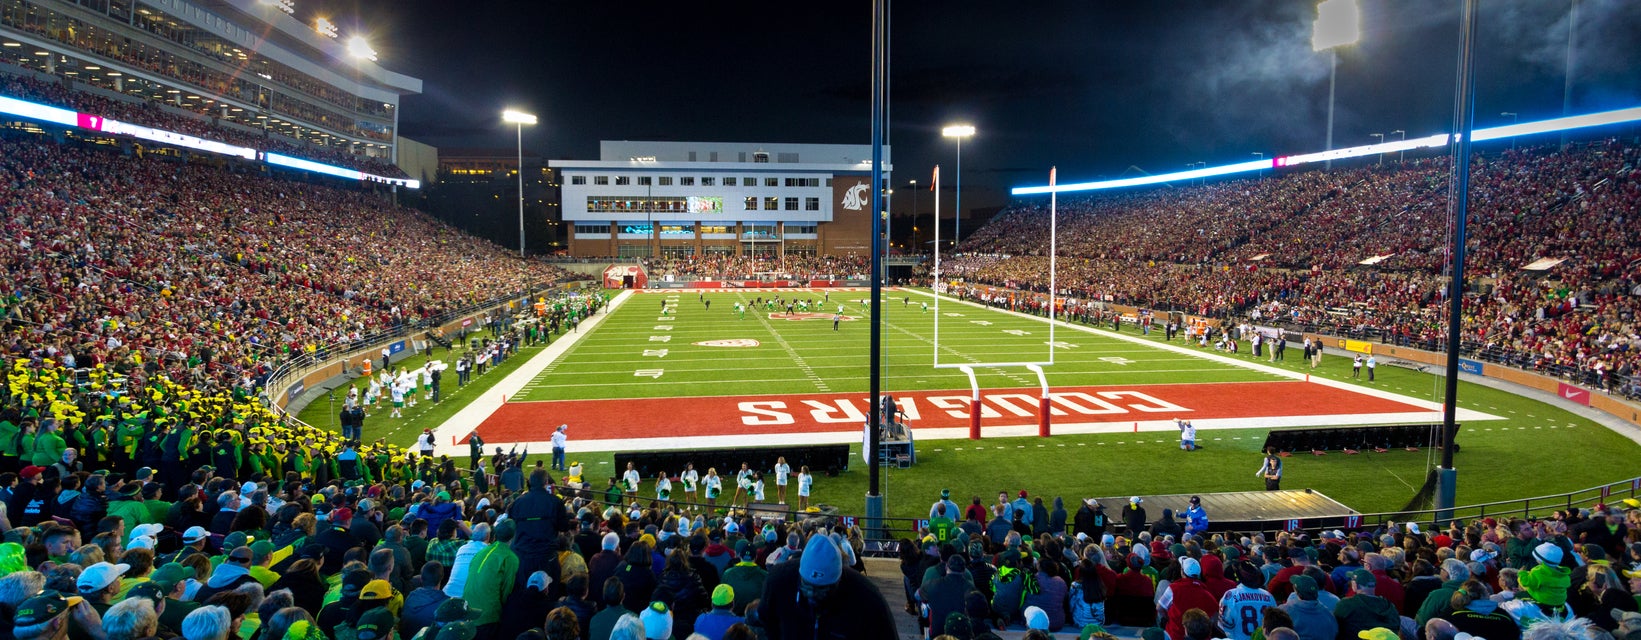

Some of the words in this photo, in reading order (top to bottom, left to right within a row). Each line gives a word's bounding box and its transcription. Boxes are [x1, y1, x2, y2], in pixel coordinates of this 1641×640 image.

[738, 391, 1195, 426] COUGARS
[843, 516, 855, 529] 15
[1287, 519, 1299, 532] 16
[1348, 516, 1359, 529] 17
[938, 528, 946, 541] 8
